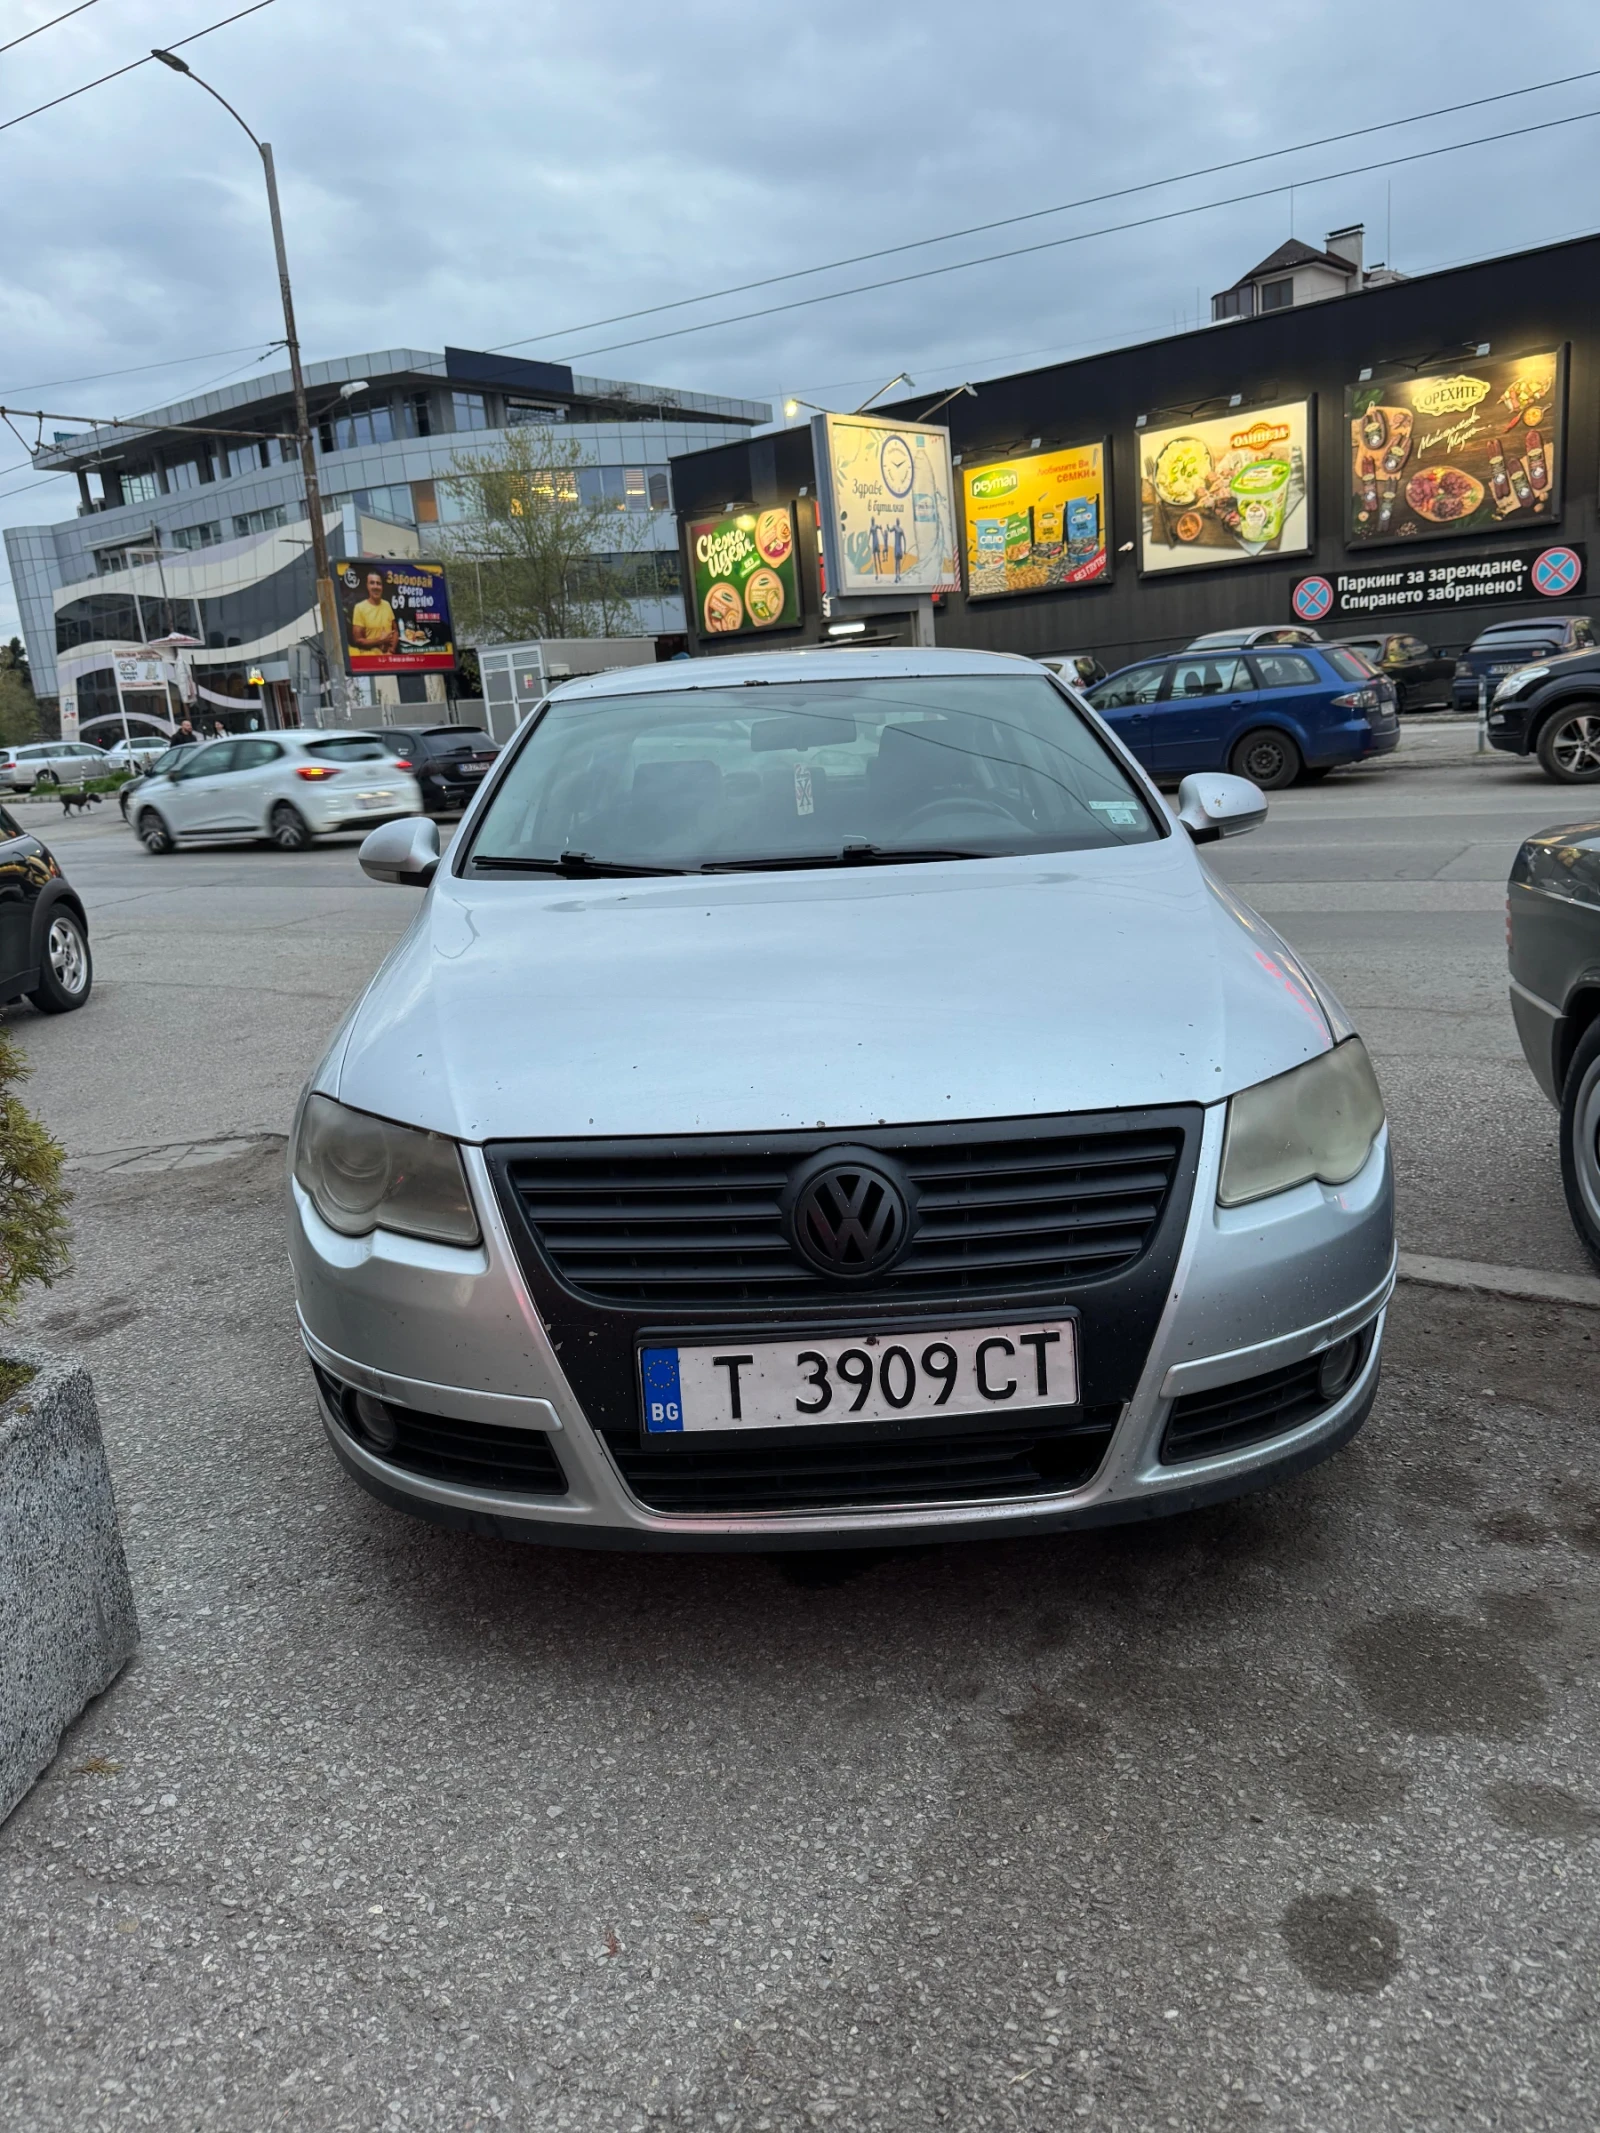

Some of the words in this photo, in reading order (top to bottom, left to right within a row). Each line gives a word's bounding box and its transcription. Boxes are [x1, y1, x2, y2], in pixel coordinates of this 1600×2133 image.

[1424, 386, 1478, 406] ОРЕХИТЕ
[1078, 460, 1089, 469] Ви
[852, 478, 883, 498] Здраве
[973, 474, 1017, 496] peyman
[873, 500, 905, 516] бутилка
[696, 529, 746, 563] Свежа
[1073, 568, 1087, 582] БЕЗ
[1337, 572, 1404, 594] Паркинг
[1406, 570, 1425, 585] за
[1428, 559, 1529, 583] зареждане.
[391, 595, 405, 610] 69
[1340, 589, 1423, 611] Спирането
[1427, 575, 1524, 602] забранено!
[712, 1354, 754, 1420] T
[795, 1340, 959, 1414] 3909
[974, 1331, 1061, 1401] CT
[651, 1403, 679, 1422] BG
